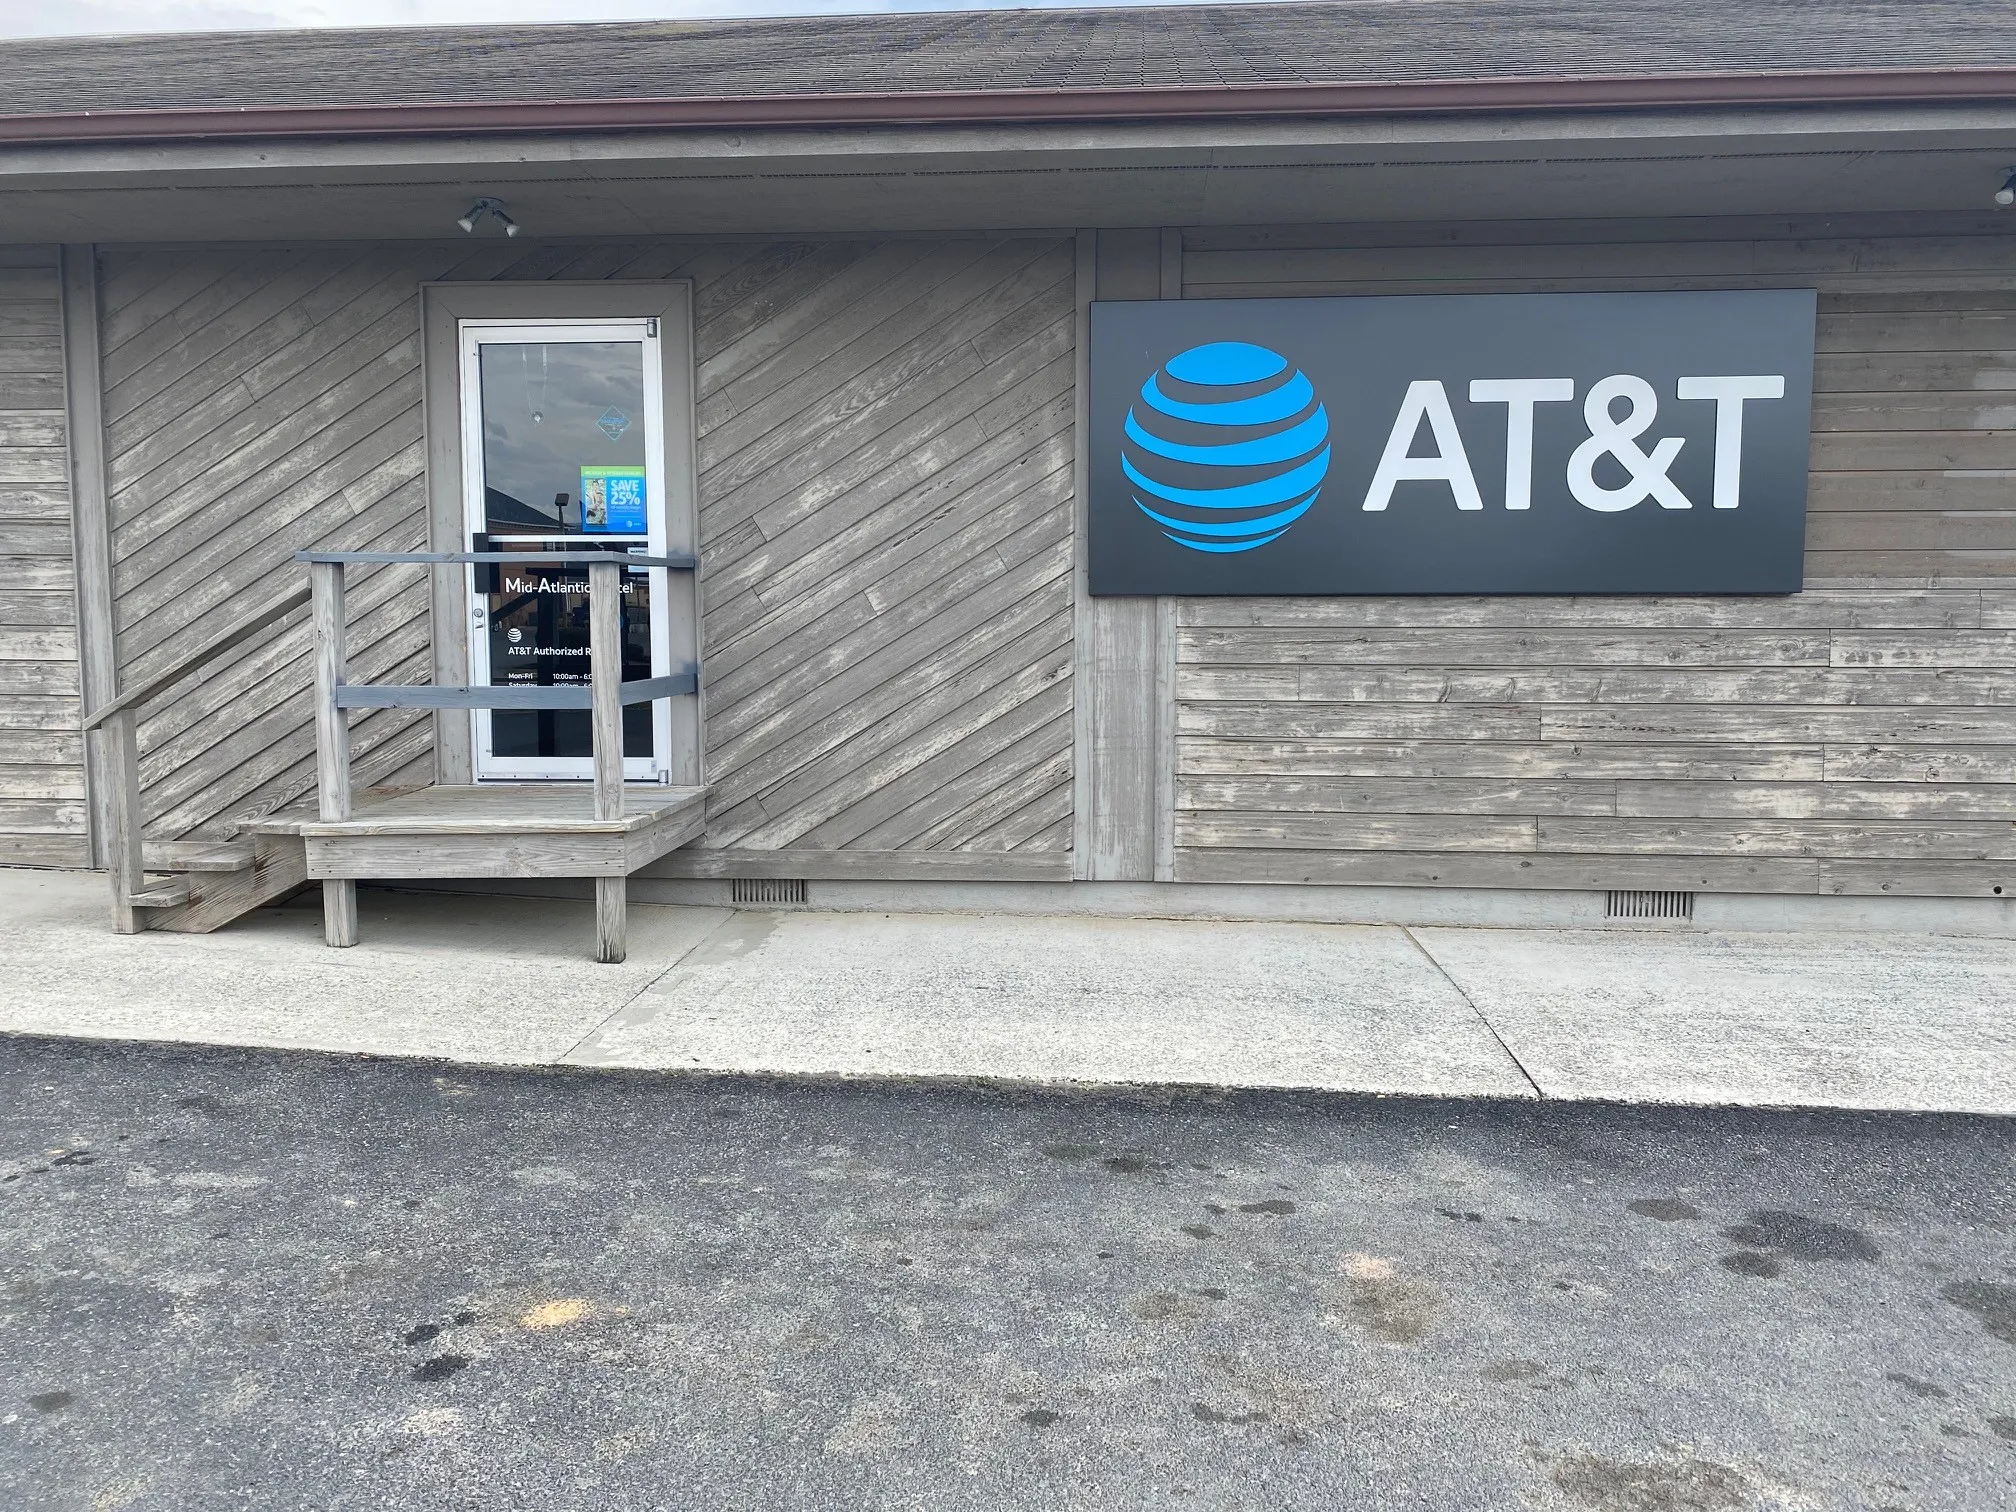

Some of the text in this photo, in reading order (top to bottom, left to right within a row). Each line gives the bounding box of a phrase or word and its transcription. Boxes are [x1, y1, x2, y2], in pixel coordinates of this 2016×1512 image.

[1361, 373, 1785, 513] AT&T
[610, 479, 640, 492] SAVE
[610, 491, 641, 505] 25%
[505, 577, 592, 594] Mid-Atlantic
[507, 646, 532, 656] AT&T
[533, 646, 584, 656] Authorized
[508, 672, 533, 680] Mon-Fri
